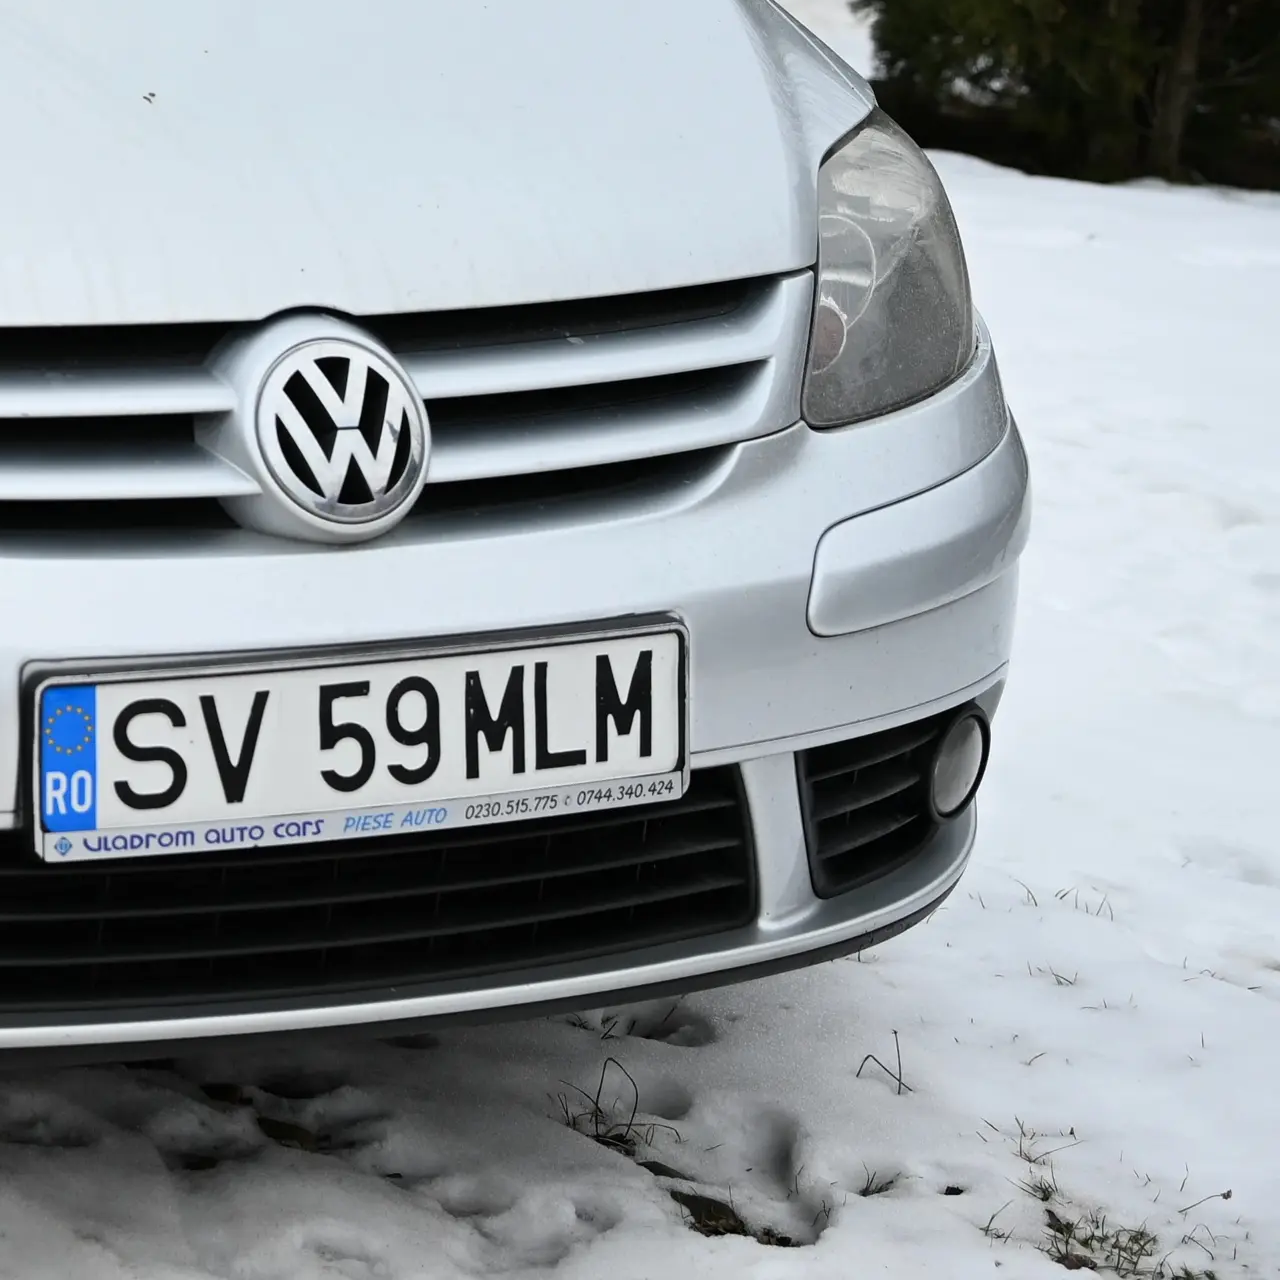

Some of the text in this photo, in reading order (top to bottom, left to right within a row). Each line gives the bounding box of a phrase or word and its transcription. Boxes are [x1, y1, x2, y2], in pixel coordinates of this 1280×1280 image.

[262, 340, 421, 520] VW
[45, 770, 93, 816] RO
[112, 689, 271, 810] SV
[343, 812, 393, 834] PIESE
[400, 807, 448, 828] AUTO
[465, 794, 558, 820] 0230.515.775
[576, 779, 674, 806] 0744.340.424
